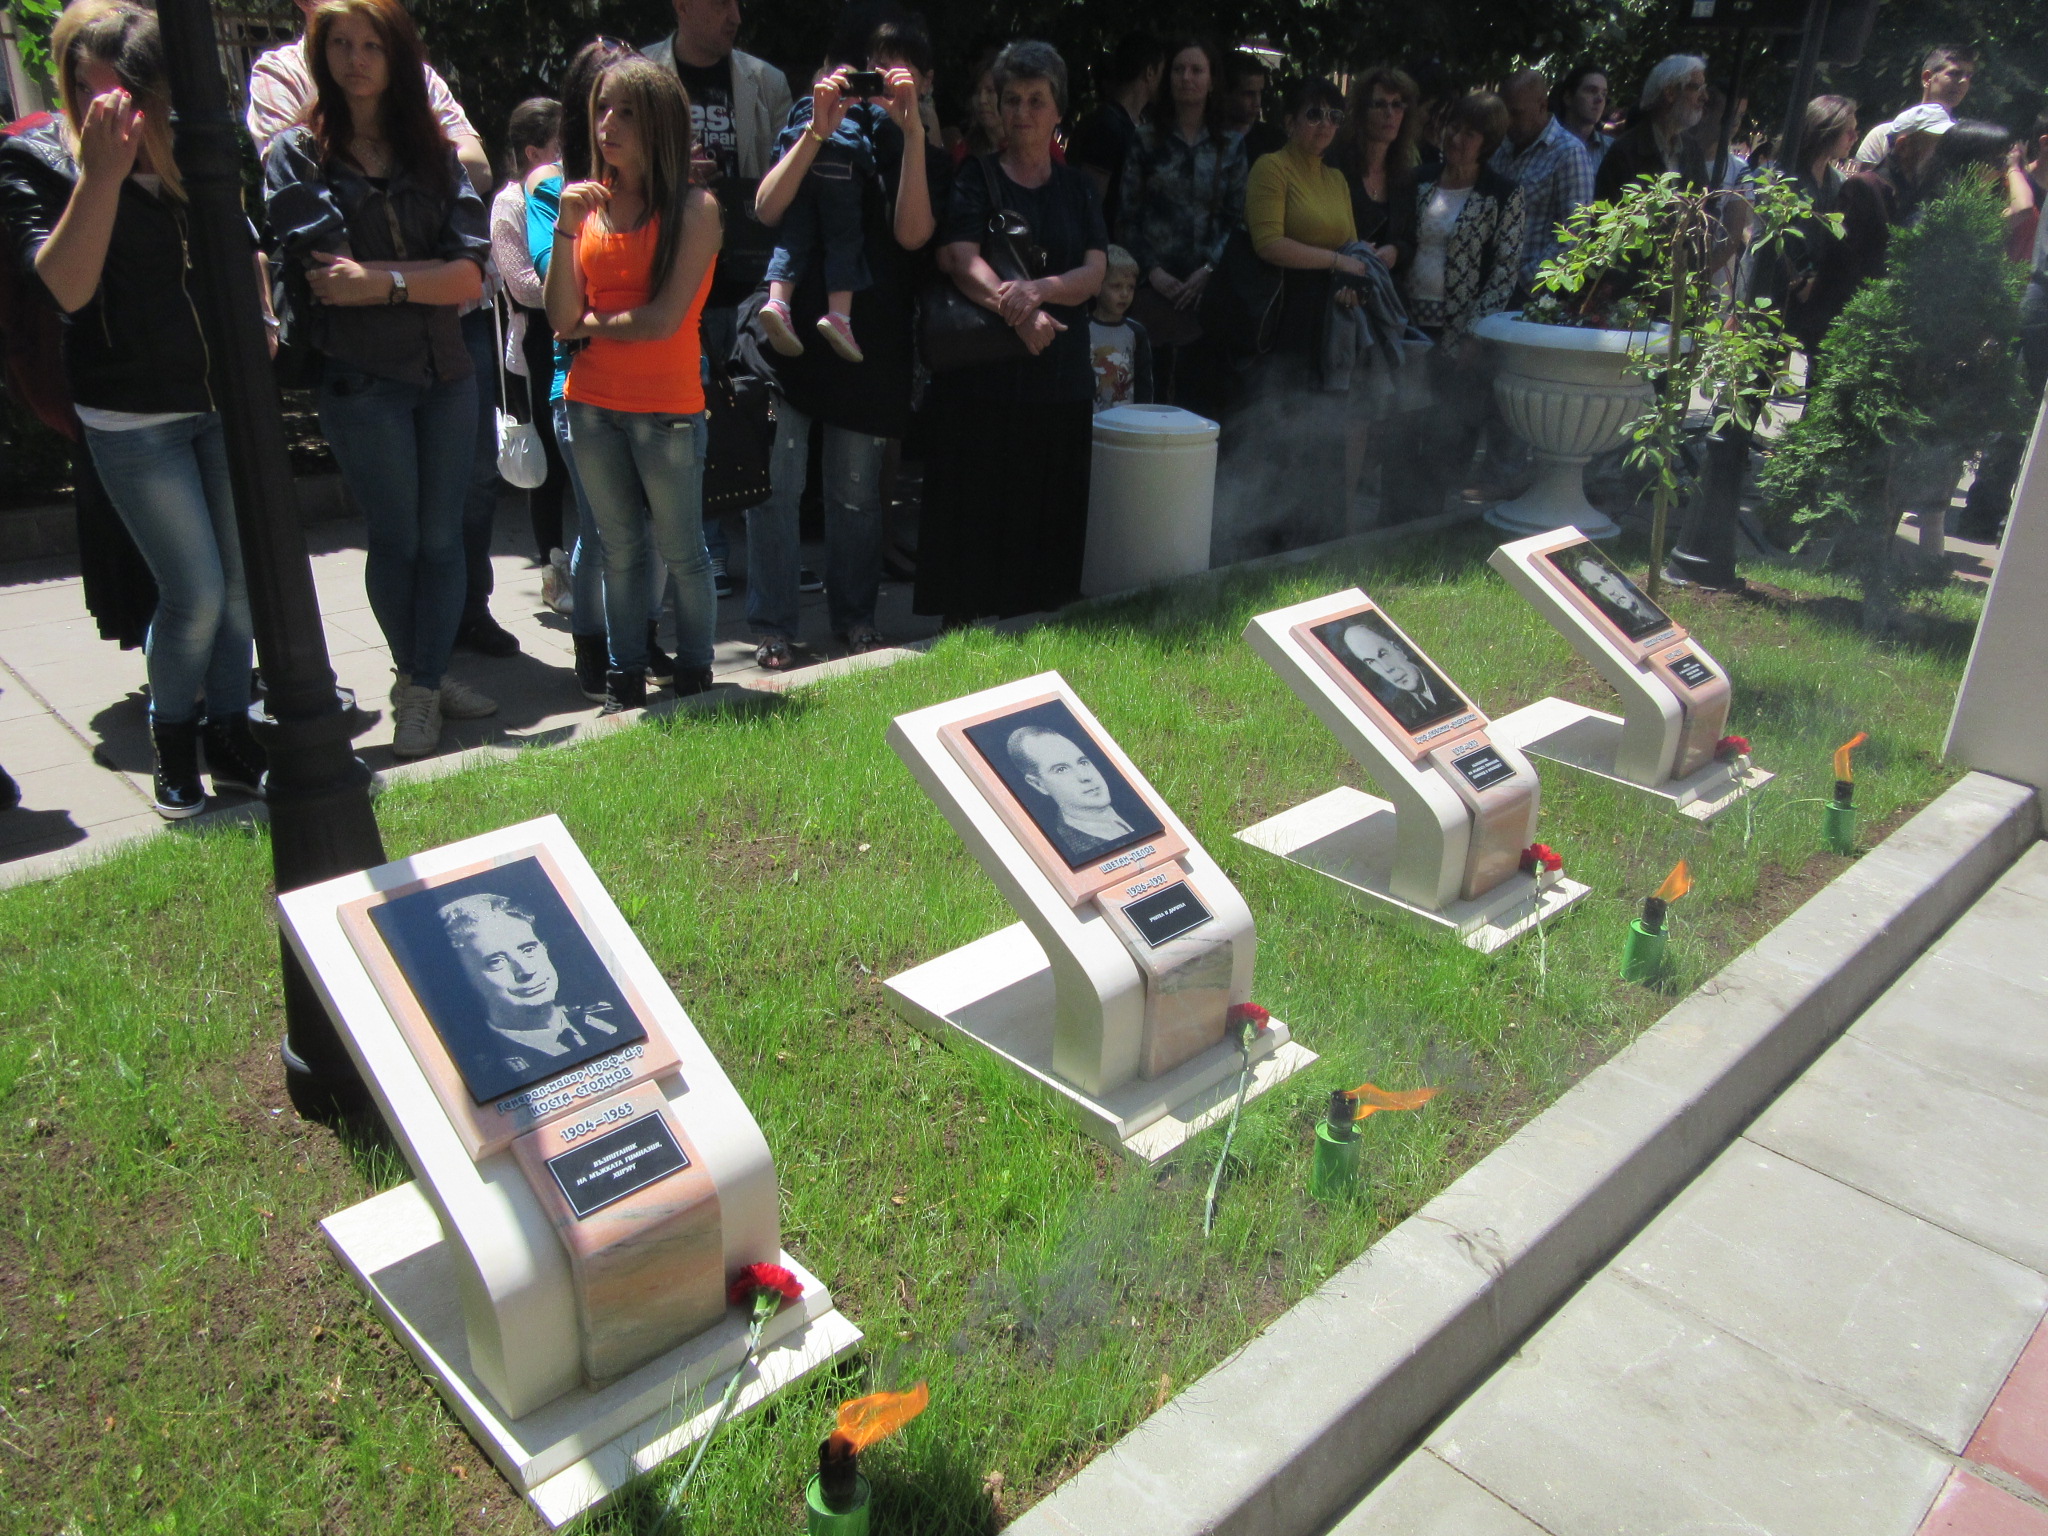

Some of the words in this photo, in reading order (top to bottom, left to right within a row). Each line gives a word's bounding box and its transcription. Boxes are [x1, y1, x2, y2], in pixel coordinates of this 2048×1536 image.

[530, 1093, 573, 1117] КОСТА
[575, 1066, 632, 1097] СТОЯНОВ
[577, 1176, 588, 1185] НА
